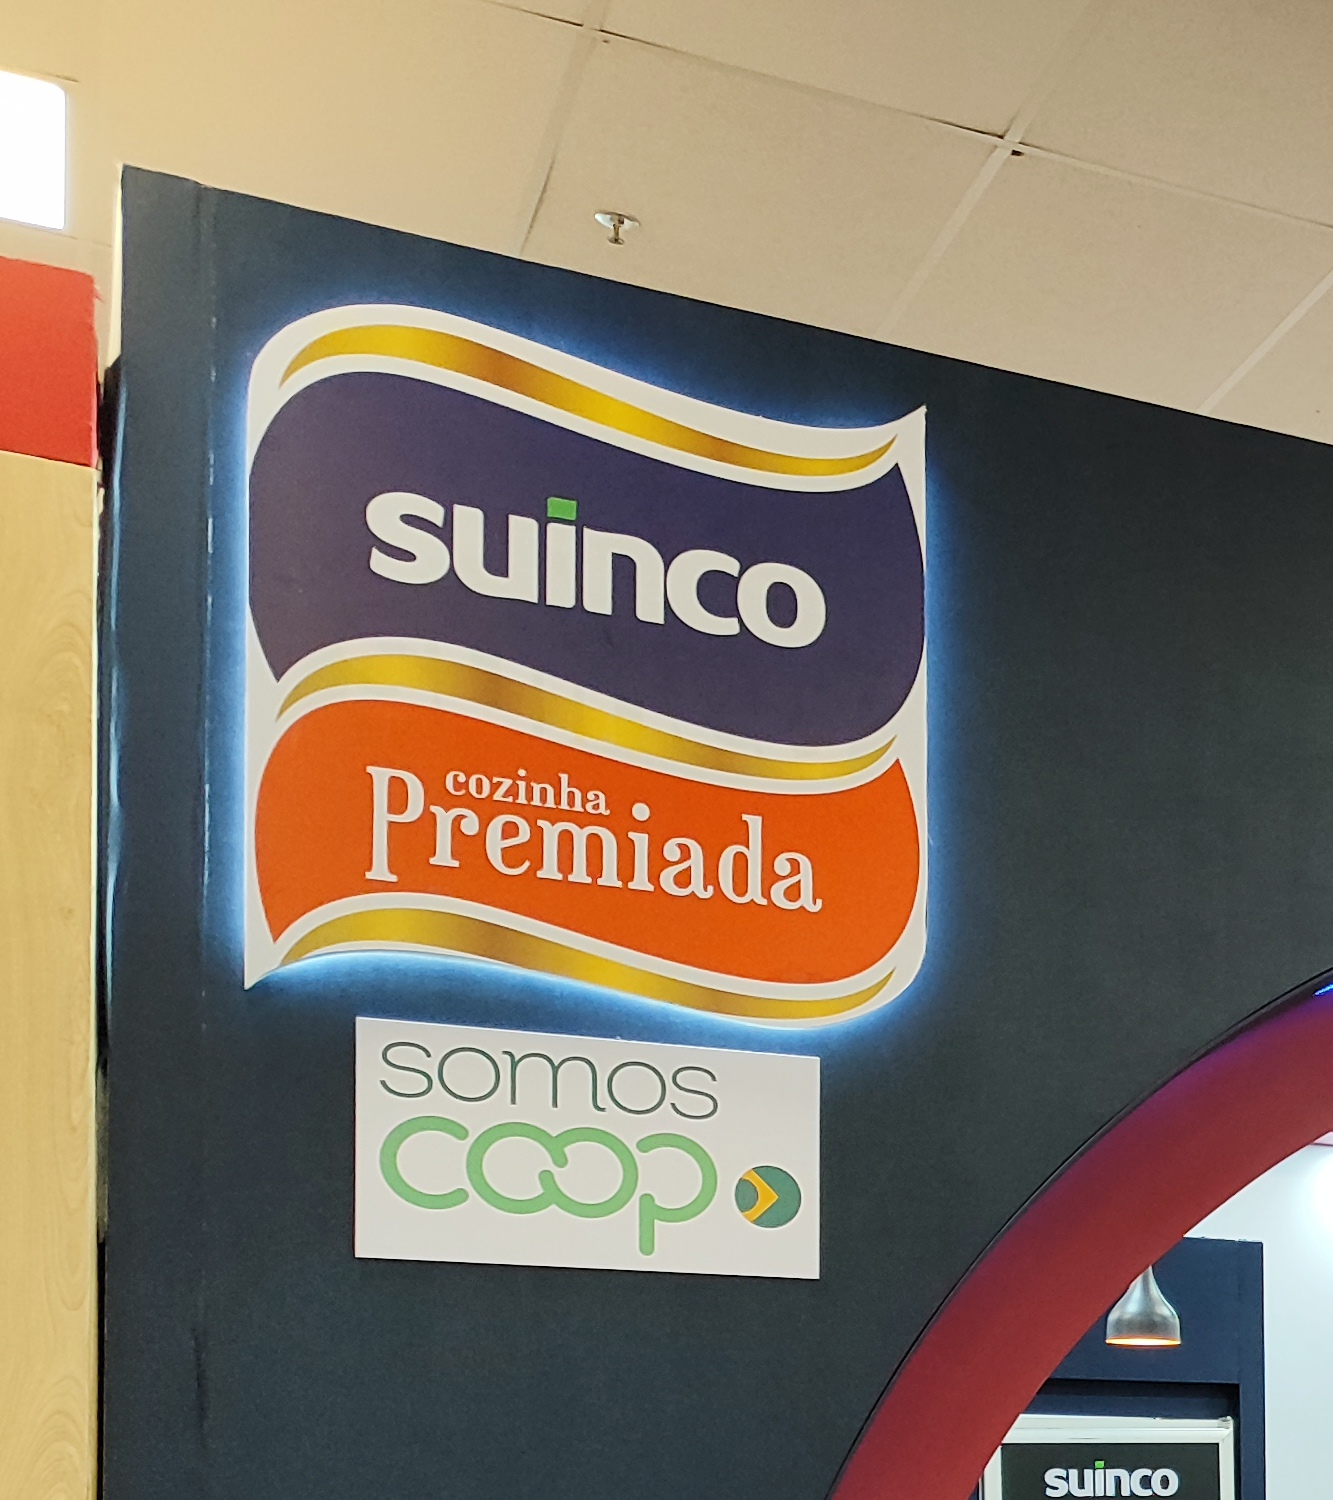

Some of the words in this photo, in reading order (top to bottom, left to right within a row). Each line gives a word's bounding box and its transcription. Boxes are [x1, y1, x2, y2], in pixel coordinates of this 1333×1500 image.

[365, 492, 826, 647] suinco
[364, 765, 823, 913] Premiada
[445, 770, 610, 817] cozinha
[379, 1041, 718, 1120] somos
[379, 1115, 718, 1256] coop
[1044, 1461, 1179, 1498] suinco
